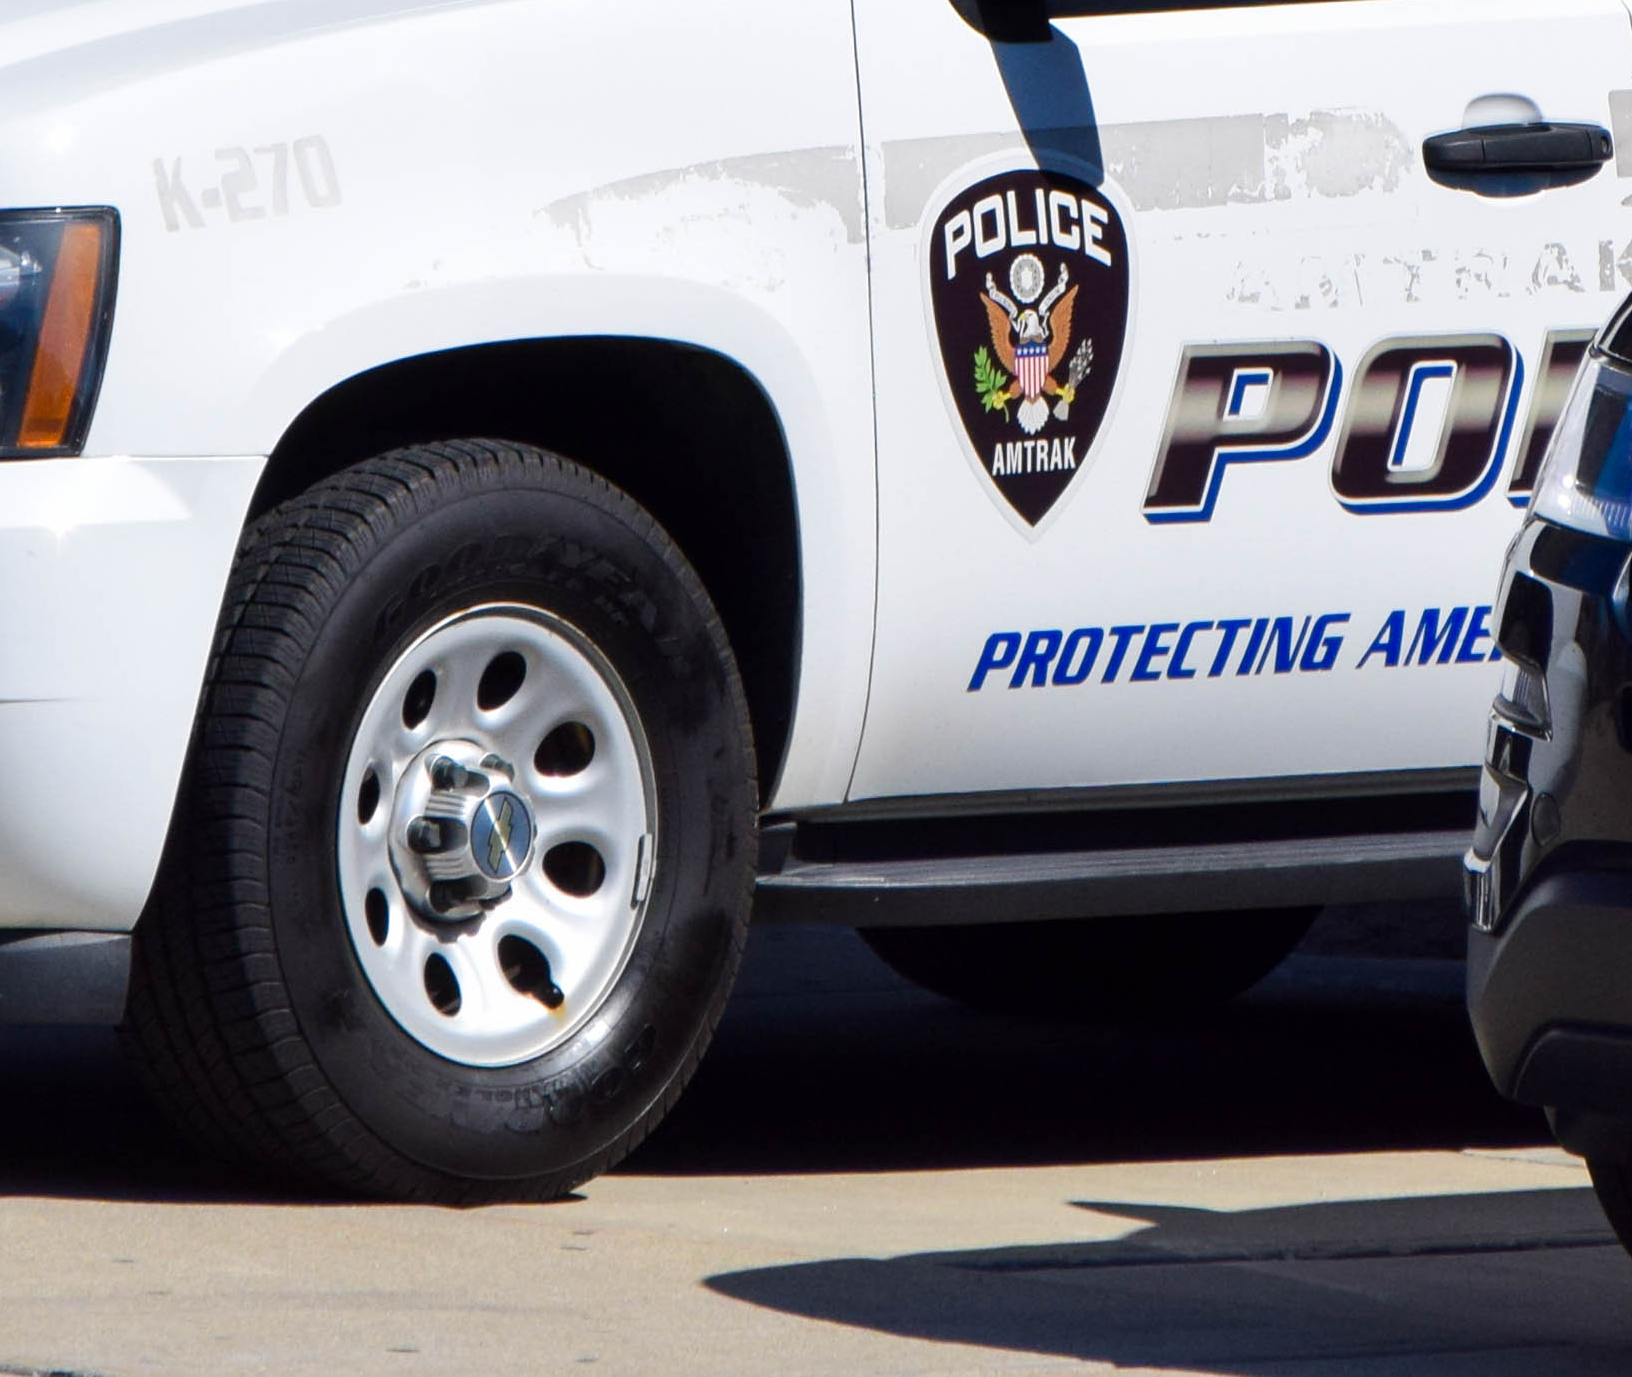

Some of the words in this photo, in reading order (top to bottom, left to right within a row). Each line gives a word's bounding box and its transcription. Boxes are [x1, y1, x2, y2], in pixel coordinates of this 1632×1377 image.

[152, 134, 341, 232] K-270
[944, 189, 1113, 280] POLICE
[992, 437, 1077, 477] AMTRAK
[967, 612, 1351, 693] PROTECTING
[1355, 605, 1503, 670] AME
